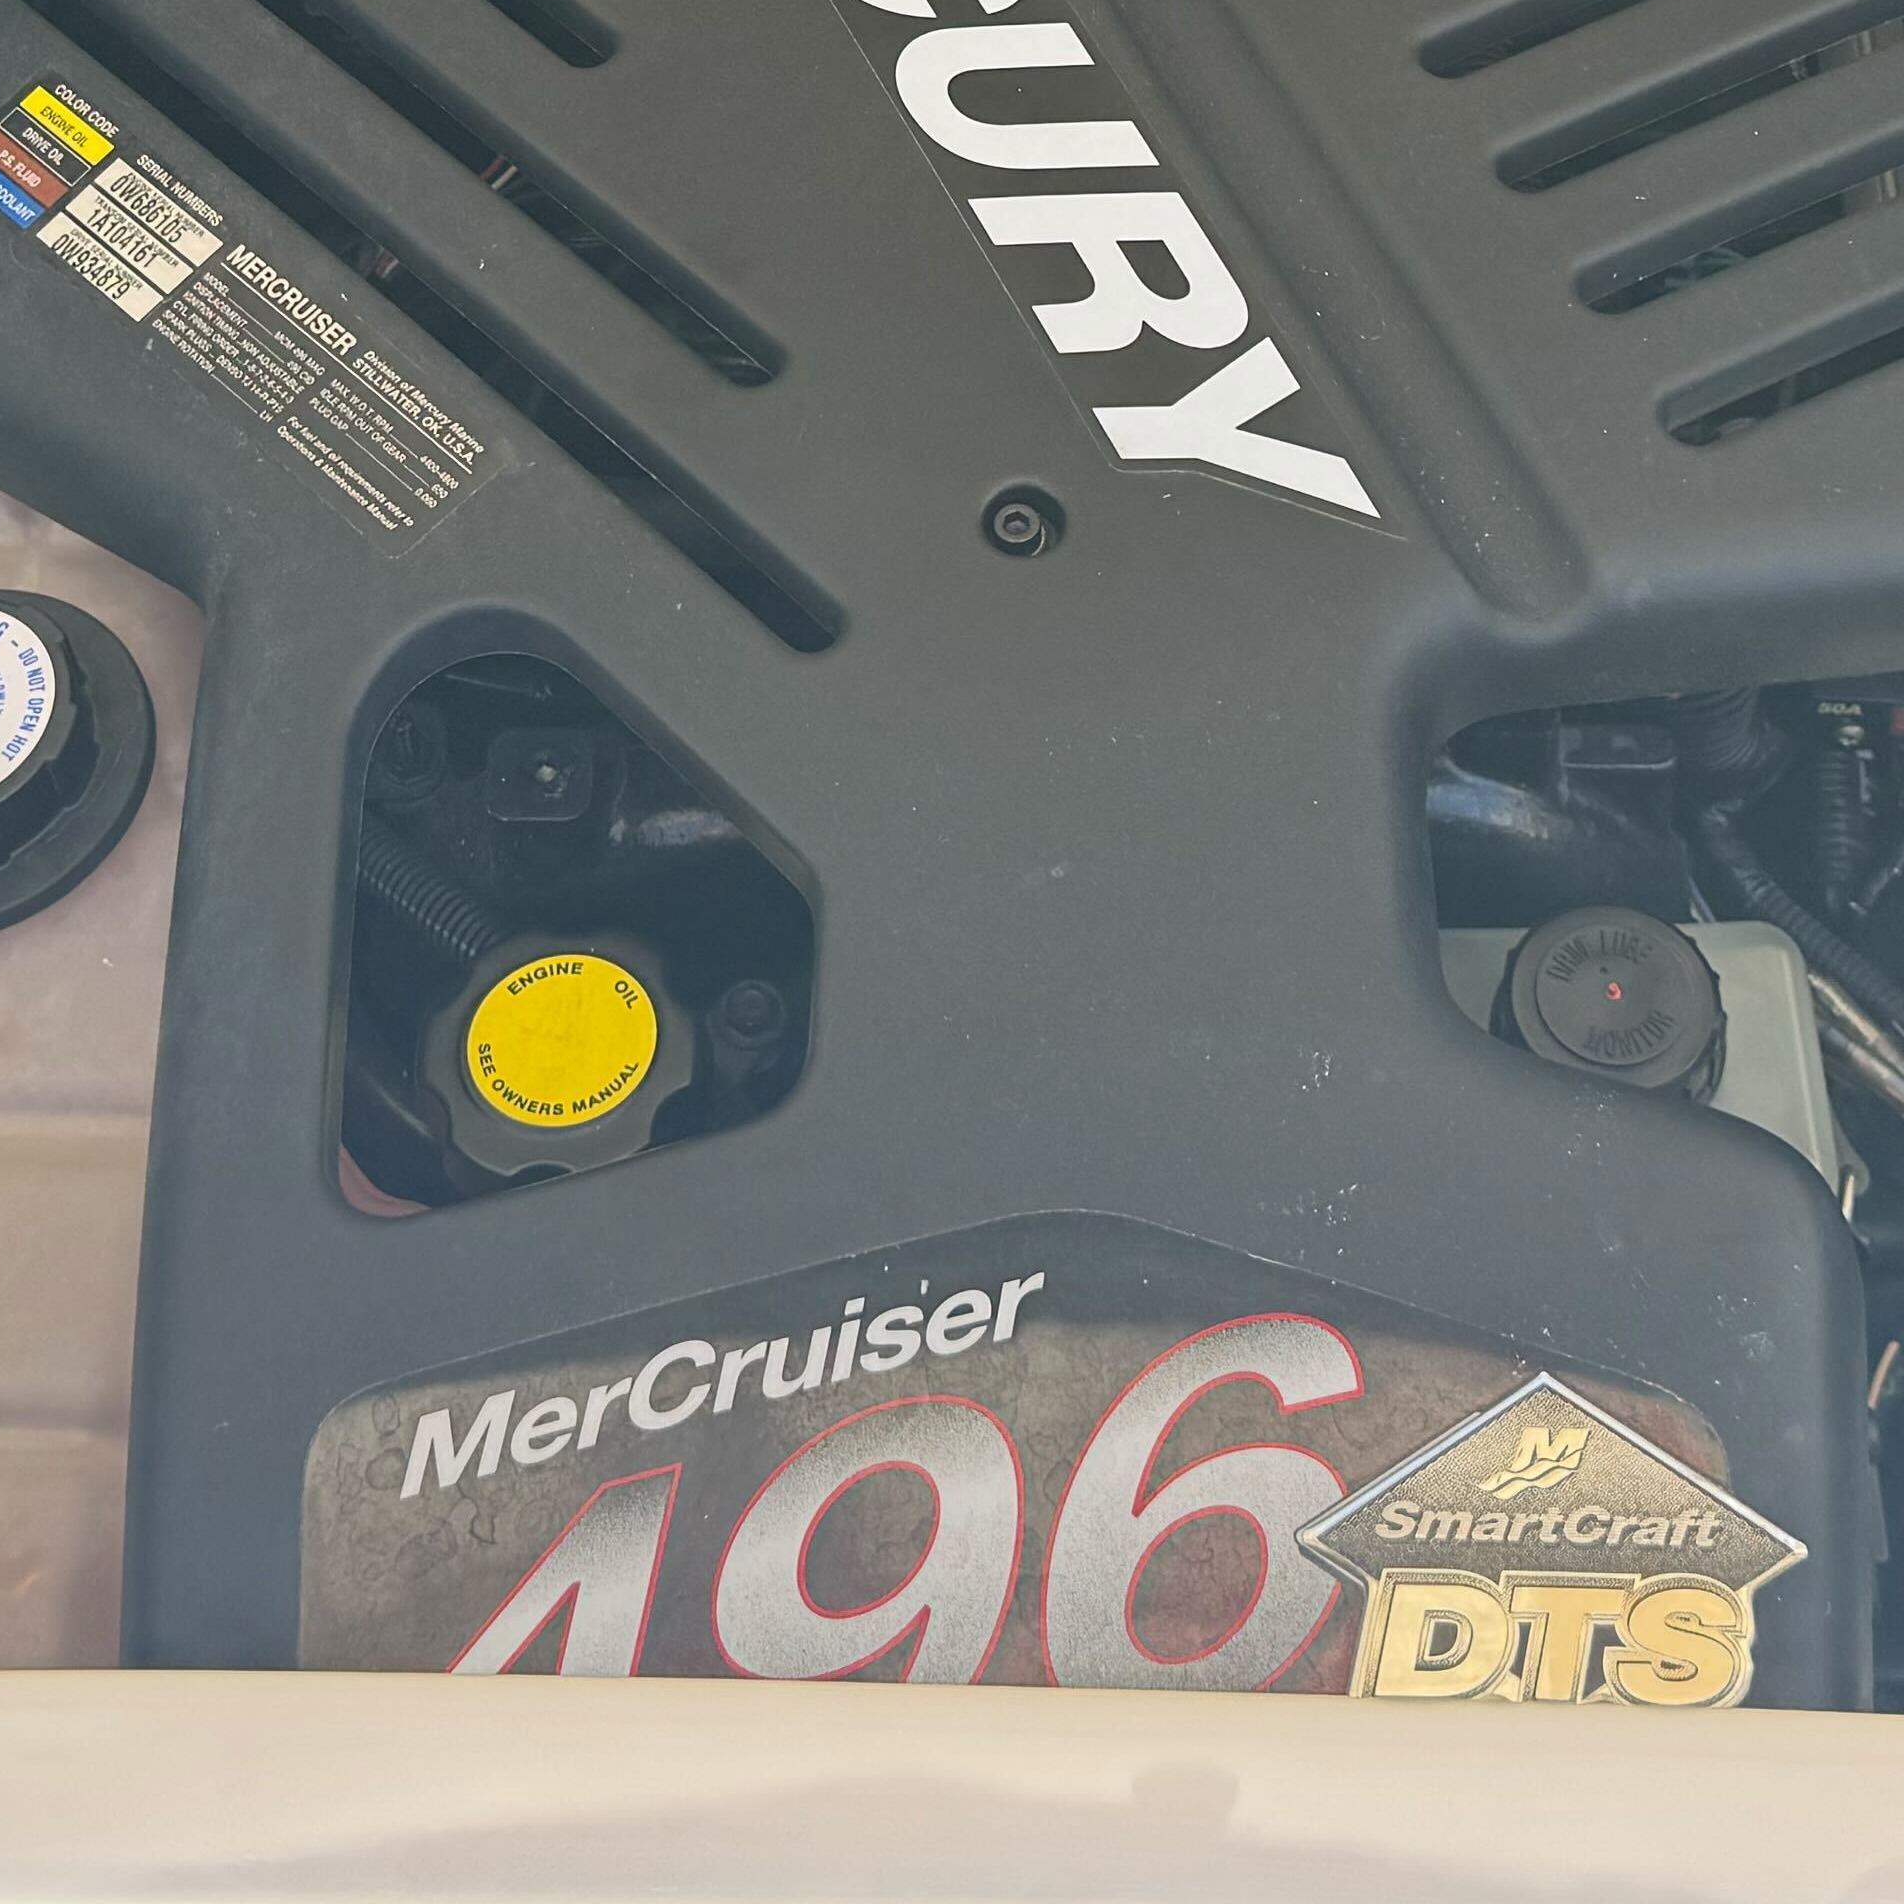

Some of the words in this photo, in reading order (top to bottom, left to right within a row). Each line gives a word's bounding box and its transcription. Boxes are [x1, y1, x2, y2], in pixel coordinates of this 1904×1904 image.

[40, 105, 74, 136] ENGINE
[72, 131, 88, 148] OIL
[54, 84, 91, 117] COLOR
[88, 110, 120, 138] CODE
[22, 127, 52, 154] DRIVE
[47, 149, 65, 166] OIL
[13, 163, 42, 188] FLUID
[136, 154, 173, 187] SERIAL
[170, 181, 223, 227] NUMBERS
[110, 175, 188, 243] 0W686105
[86, 209, 158, 268] 1A104161
[50, 233, 131, 300] 0W934879
[192, 280, 249, 328] DISPLACEMENT
[202, 272, 230, 298] MODEL
[304, 355, 326, 376] MAG
[226, 244, 358, 356] MERCRUISER
[162, 309, 188, 333] SPARK
[185, 328, 213, 353] PLUGS
[182, 290, 216, 319] IGNITION
[212, 313, 242, 341] TIMING
[256, 352, 305, 395] ADJUSTABLE
[186, 312, 215, 337] FIRING
[211, 332, 240, 359] ORDER
[151, 318, 181, 345] ENGINE
[177, 340, 216, 373] ROTATION
[259, 410, 274, 423] LH
[309, 396, 333, 418] PLUG
[330, 415, 350, 431] GAP
[320, 387, 339, 407] IDLE
[336, 400, 357, 425] RPM
[354, 417, 374, 436] OUT
[371, 431, 386, 446] OF
[382, 441, 407, 463] GEAR
[364, 350, 402, 383] Division
[400, 381, 415, 392] of
[410, 388, 453, 427] Mercury
[449, 420, 485, 454] Marine
[372, 413, 395, 434] RPM
[277, 425, 317, 462] Operations
[320, 465, 369, 507] Maintenance
[366, 501, 399, 531] Manual
[287, 415, 303, 431] For
[302, 426, 318, 443] fuel
[314, 439, 331, 456] and
[336, 457, 387, 503] requirements
[383, 499, 407, 520] refer
[404, 514, 415, 527] to
[18, 647, 38, 666] DO
[26, 666, 46, 692] NOT
[22, 697, 45, 733] OPEN
[0, 734, 28, 763] HOT
[1599, 929, 1654, 966] LUBE
[506, 961, 584, 996] ENGINE
[614, 979, 639, 1010] OIL
[1583, 1008, 1676, 1058] MONITOR
[478, 1042, 497, 1078] SEE
[491, 1078, 564, 1116] OWNERS
[571, 1061, 640, 1114] MANUAL
[399, 1270, 1046, 1501] MerCruiser
[1375, 1501, 1722, 1549] SmartCraft
[1364, 1570, 1753, 1707] DTS
